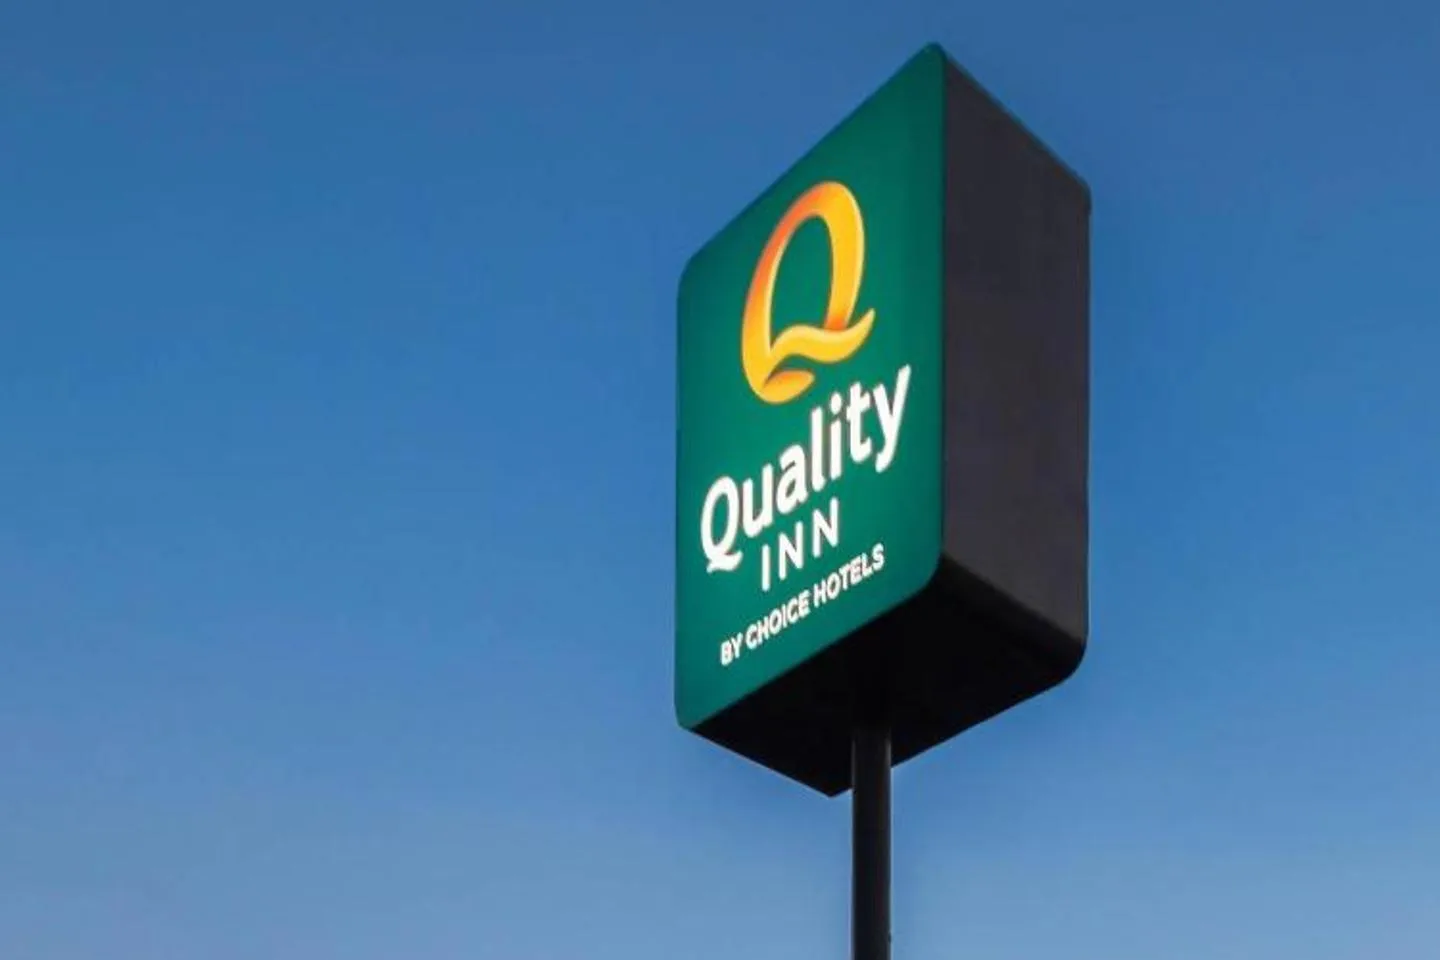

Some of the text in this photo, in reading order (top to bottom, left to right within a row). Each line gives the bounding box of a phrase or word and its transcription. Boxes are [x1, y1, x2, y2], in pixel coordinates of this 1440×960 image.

[741, 179, 876, 404] Q
[700, 363, 912, 574] Quality
[761, 497, 839, 592] INN
[720, 543, 885, 666] BY CHOICE HOTELS
